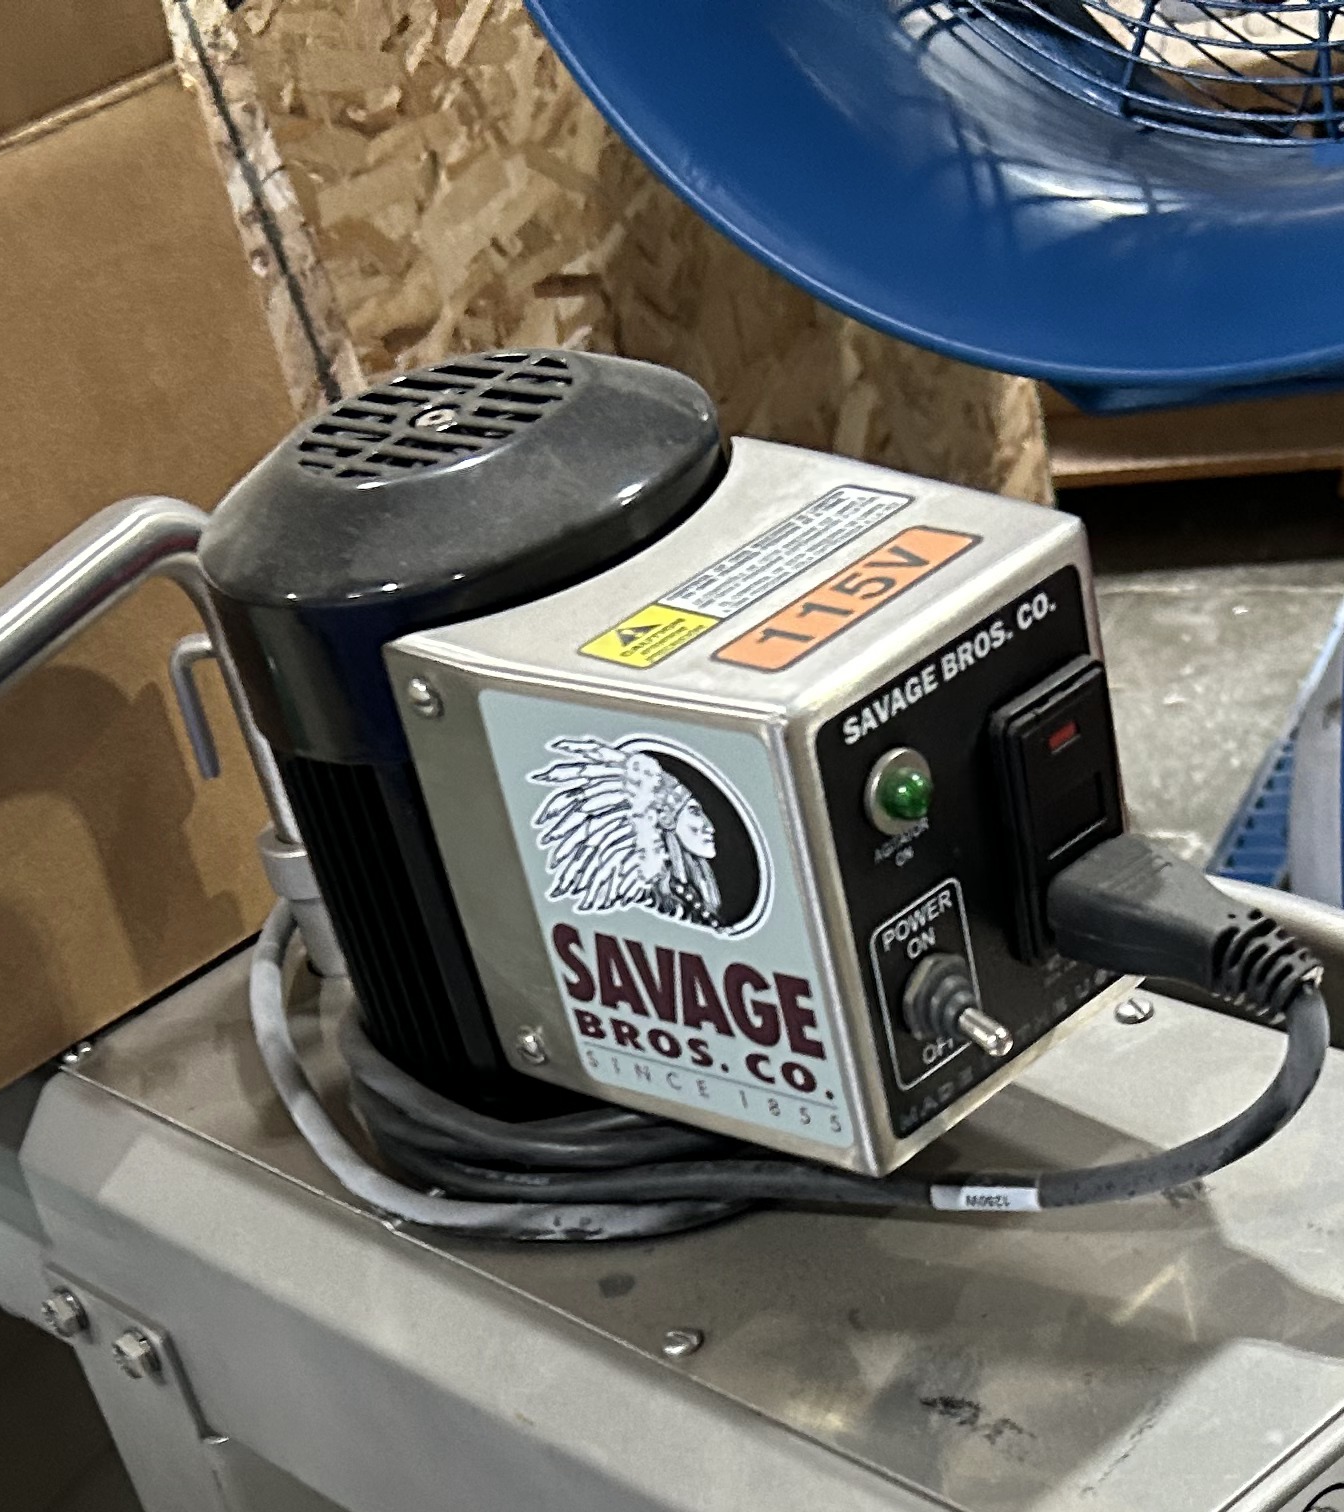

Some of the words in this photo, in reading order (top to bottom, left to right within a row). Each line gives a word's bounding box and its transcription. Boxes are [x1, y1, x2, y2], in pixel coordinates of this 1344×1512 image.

[755, 540, 925, 648] 115V
[841, 663, 938, 747] SAVAGE
[939, 615, 1013, 683] BROS.
[1015, 585, 1057, 633] CO.
[894, 844, 914, 868] ON
[880, 888, 953, 953] POWER
[905, 925, 937, 961] ON
[551, 923, 824, 1061] SAVAGE
[576, 1011, 730, 1074] BROS.
[744, 1053, 834, 1101] CO.
[585, 1050, 711, 1099] SINCE
[738, 1089, 843, 1134] 1855
